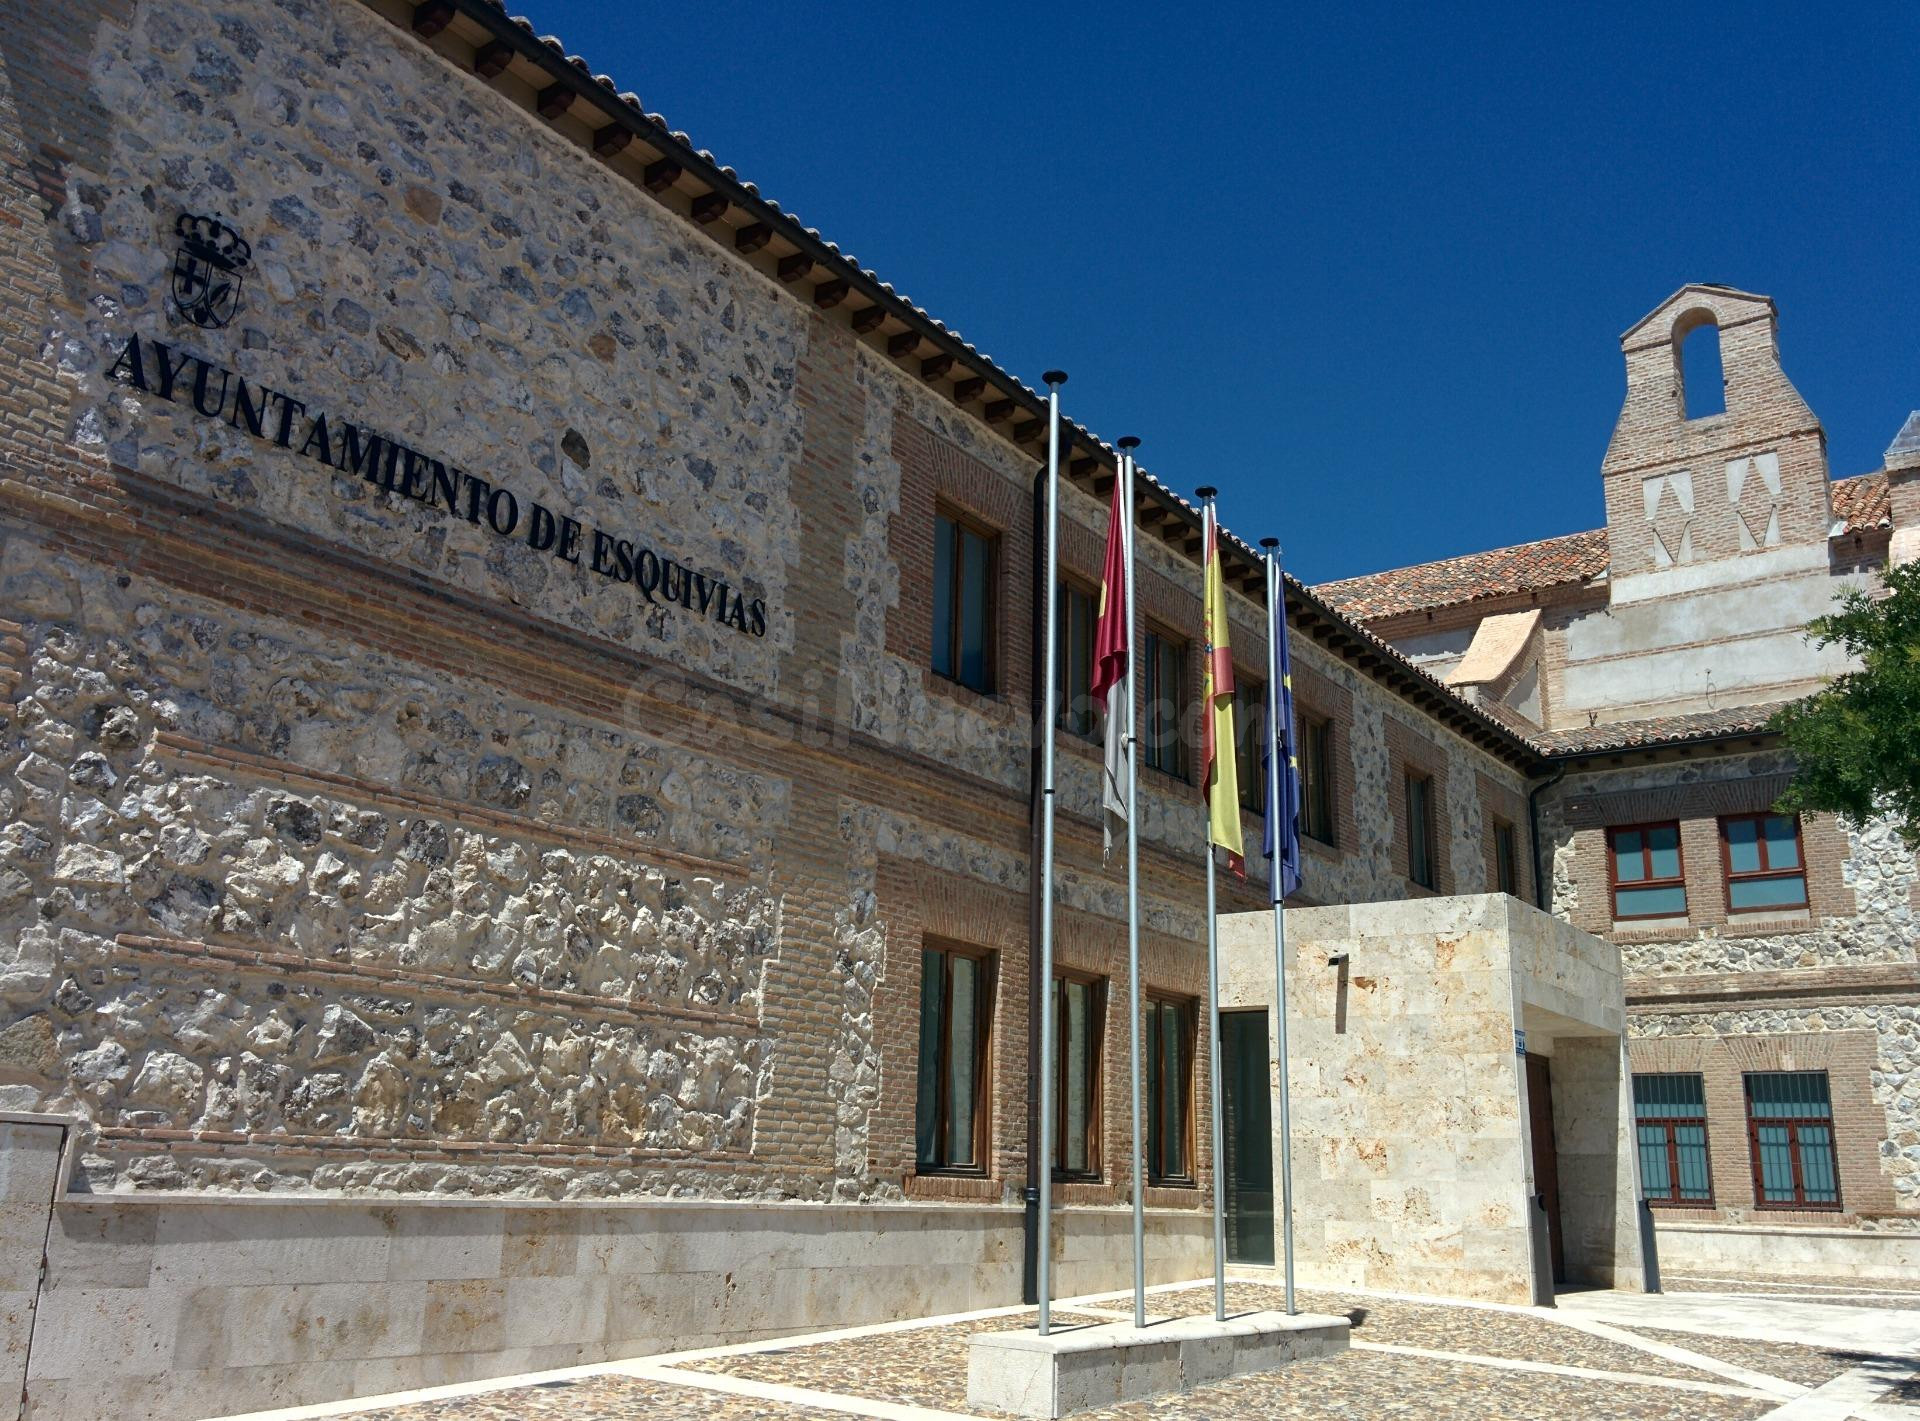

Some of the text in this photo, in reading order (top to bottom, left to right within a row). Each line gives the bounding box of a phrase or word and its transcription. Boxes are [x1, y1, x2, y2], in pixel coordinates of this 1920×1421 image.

[104, 332, 766, 638] AYUNTAMIENTO DE ESQUIVIAS
